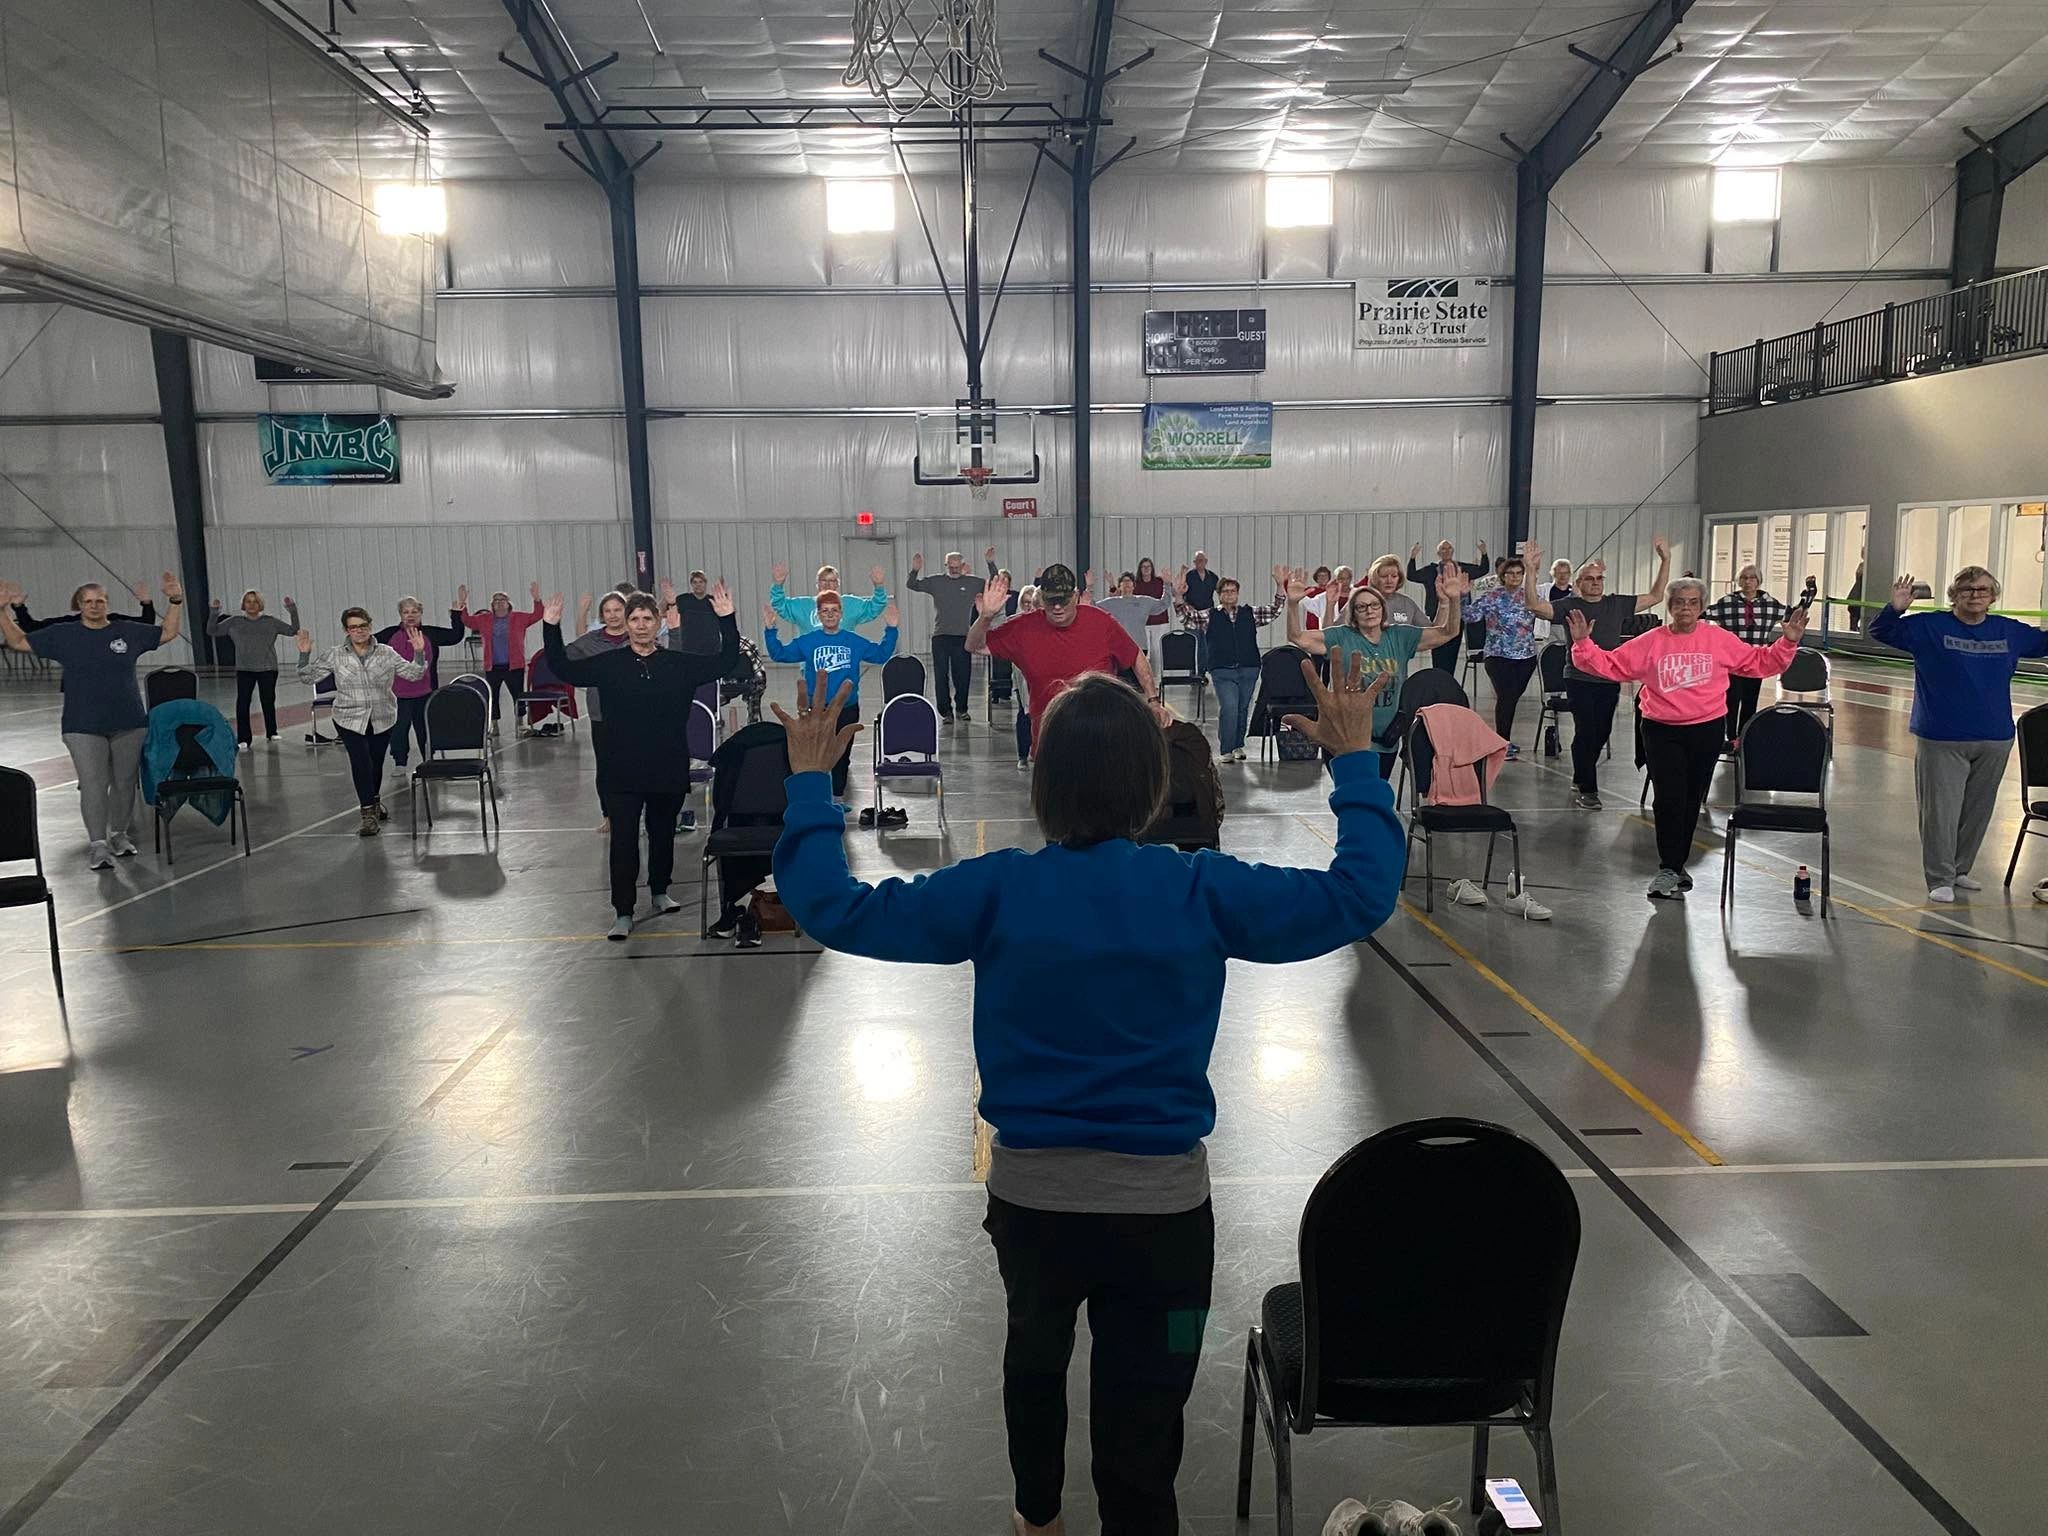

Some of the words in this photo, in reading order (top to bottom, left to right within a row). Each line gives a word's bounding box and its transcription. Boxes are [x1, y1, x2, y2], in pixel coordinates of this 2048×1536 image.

[1359, 301, 1431, 321] Prairie
[1435, 300, 1488, 321] State
[1238, 330, 1266, 341] GUEST
[1378, 322, 1413, 336] Bank
[1415, 322, 1429, 335] &
[1431, 321, 1467, 335] Trust
[1167, 431, 1243, 446] WORRELL
[263, 419, 395, 477] JNVBC
[1005, 500, 1029, 510] Court
[1659, 654, 1712, 672] FITNESS
